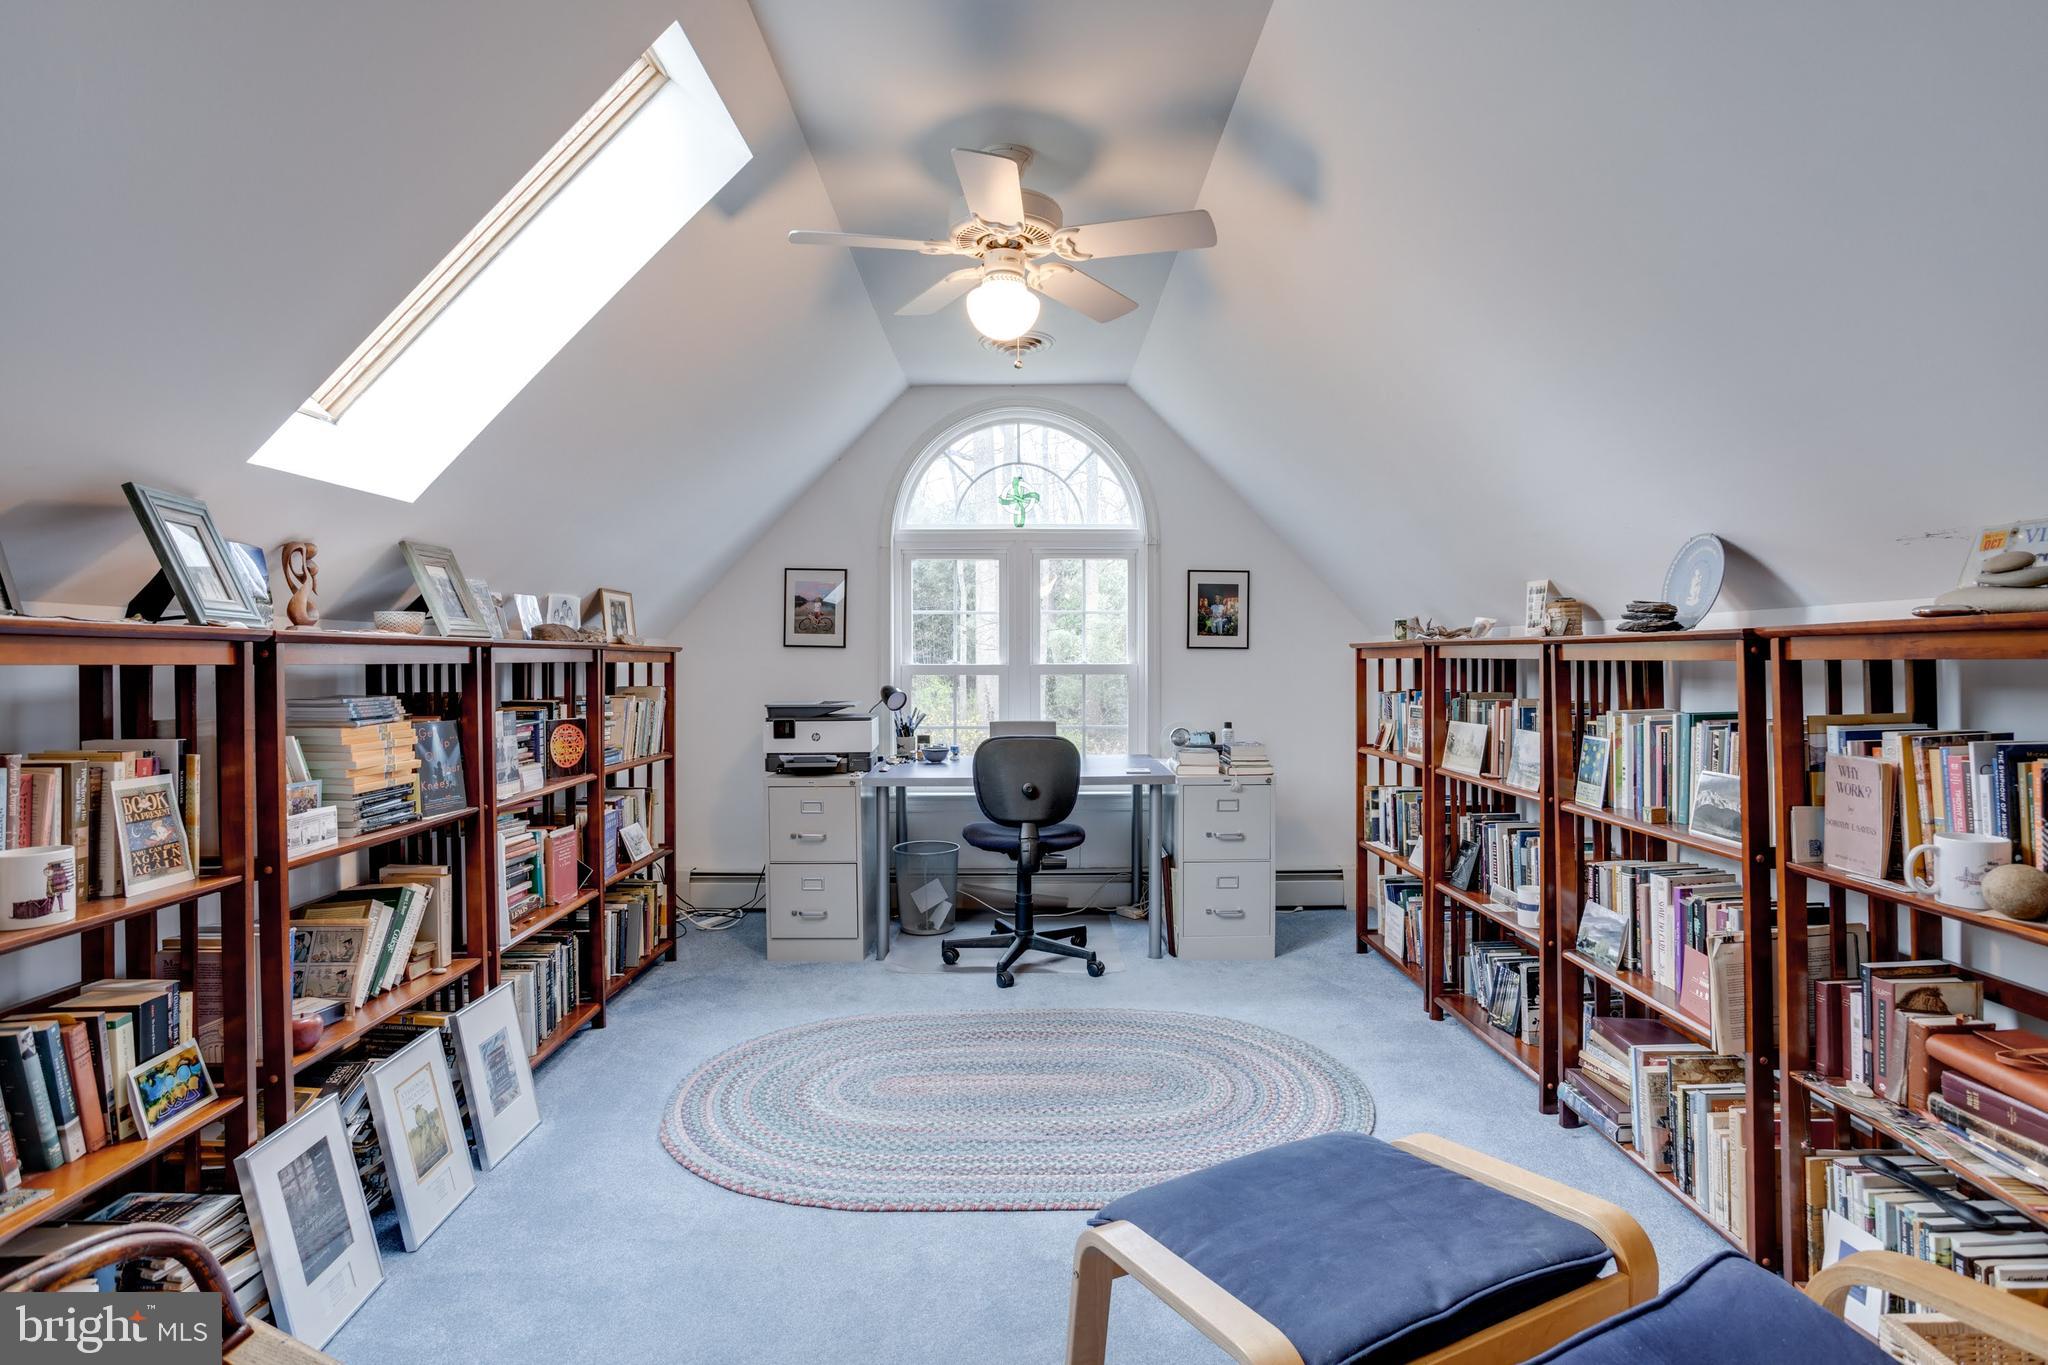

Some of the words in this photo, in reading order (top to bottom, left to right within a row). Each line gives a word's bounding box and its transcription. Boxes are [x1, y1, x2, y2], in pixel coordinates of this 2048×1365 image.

[1984, 538, 2003, 551] OCT
[1837, 764, 1860, 780] WHY
[1836, 781, 1873, 799] WORK?
[1998, 765, 2007, 801] SYMPHONY
[121, 791, 170, 815] BOOK
[2000, 802, 2007, 813] OF
[140, 807, 171, 821] PRESENT
[132, 847, 182, 867] AGAIN
[134, 857, 183, 877] AGAIN
[511, 905, 528, 920] LEWIS
[387, 929, 401, 954] College
